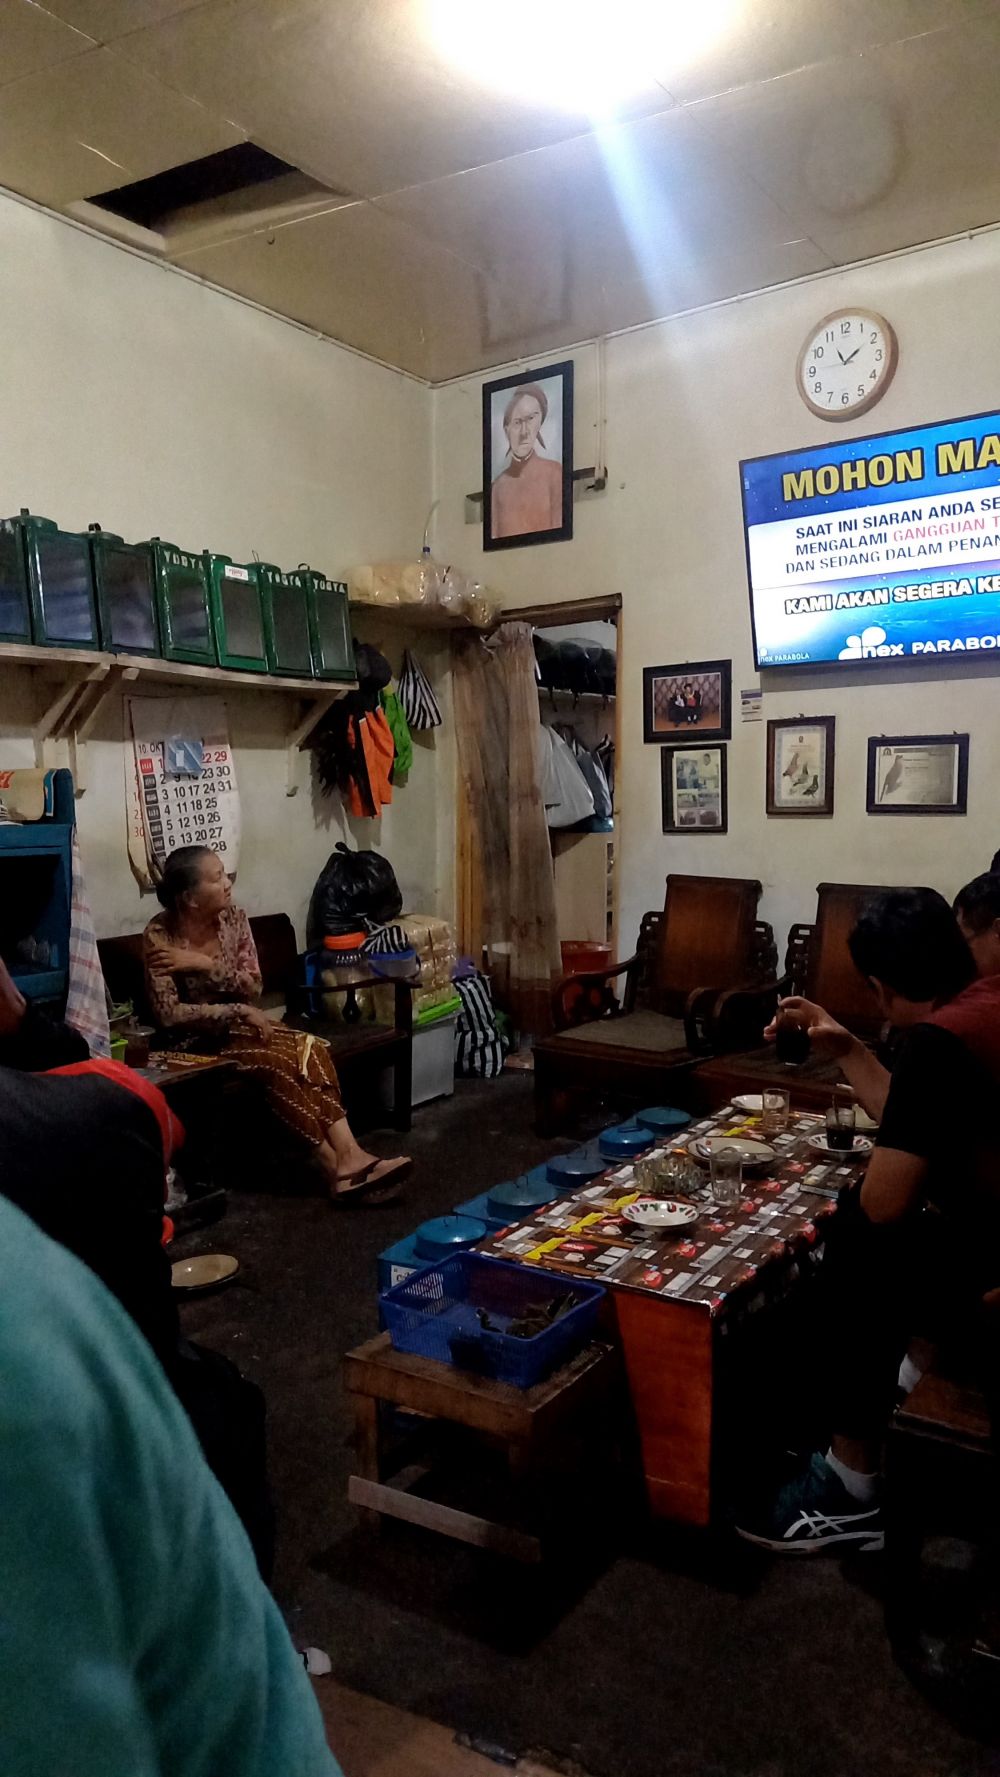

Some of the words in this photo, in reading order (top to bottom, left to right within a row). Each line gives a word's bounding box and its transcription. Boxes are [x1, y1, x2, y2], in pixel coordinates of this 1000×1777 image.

[840, 321, 851, 334] 12
[859, 322, 863, 333] 1
[825, 331, 834, 343] 11
[870, 332, 878, 344] 2
[812, 346, 824, 359] 10
[874, 349, 882, 361] 3
[808, 366, 816, 377] 9
[869, 369, 877, 379] 4
[814, 382, 822, 393] 8
[857, 384, 865, 396] 5
[826, 392, 834, 403] 7
[841, 393, 849, 404] 6
[782, 448, 923, 502] MOHON
[936, 434, 1000, 475] MA
[796, 522, 833, 539] SAAT
[838, 518, 858, 532] INI
[863, 508, 922, 529] SIARAN
[928, 500, 975, 519] ANDA
[980, 496, 1000, 511] SE
[796, 532, 887, 556] MENGALAMI
[893, 517, 985, 542] GANGGUAN
[786, 560, 815, 574] DAN
[820, 550, 880, 569] SEDANG
[886, 542, 943, 561] DALAM
[784, 594, 833, 615] KAMI
[835, 587, 890, 610] AKAN
[892, 577, 973, 603] SEGERA
[976, 574, 1000, 595] KE
[774, 652, 810, 662] PARABOLA
[862, 643, 905, 659] nex
[214, 750, 228, 762] 29
[160, 773, 167, 785] 2
[201, 767, 214, 780] 23
[216, 765, 231, 778] 30
[162, 788, 169, 800] 3
[174, 786, 186, 799] 10
[188, 784, 200, 797] 17
[202, 782, 216, 795] 24
[217, 779, 232, 792] 31
[164, 804, 171, 815] 4
[177, 801, 188, 814] 11
[190, 798, 203, 811] 18
[205, 797, 218, 810] 25
[166, 819, 173, 831] 5
[177, 816, 191, 829] 12
[193, 813, 205, 826] 19
[207, 811, 221, 824] 26
[168, 834, 176, 847] 6
[180, 831, 193, 844] 13
[194, 828, 208, 842] 20
[208, 826, 222, 839] 27
[211, 840, 227, 853] 28
